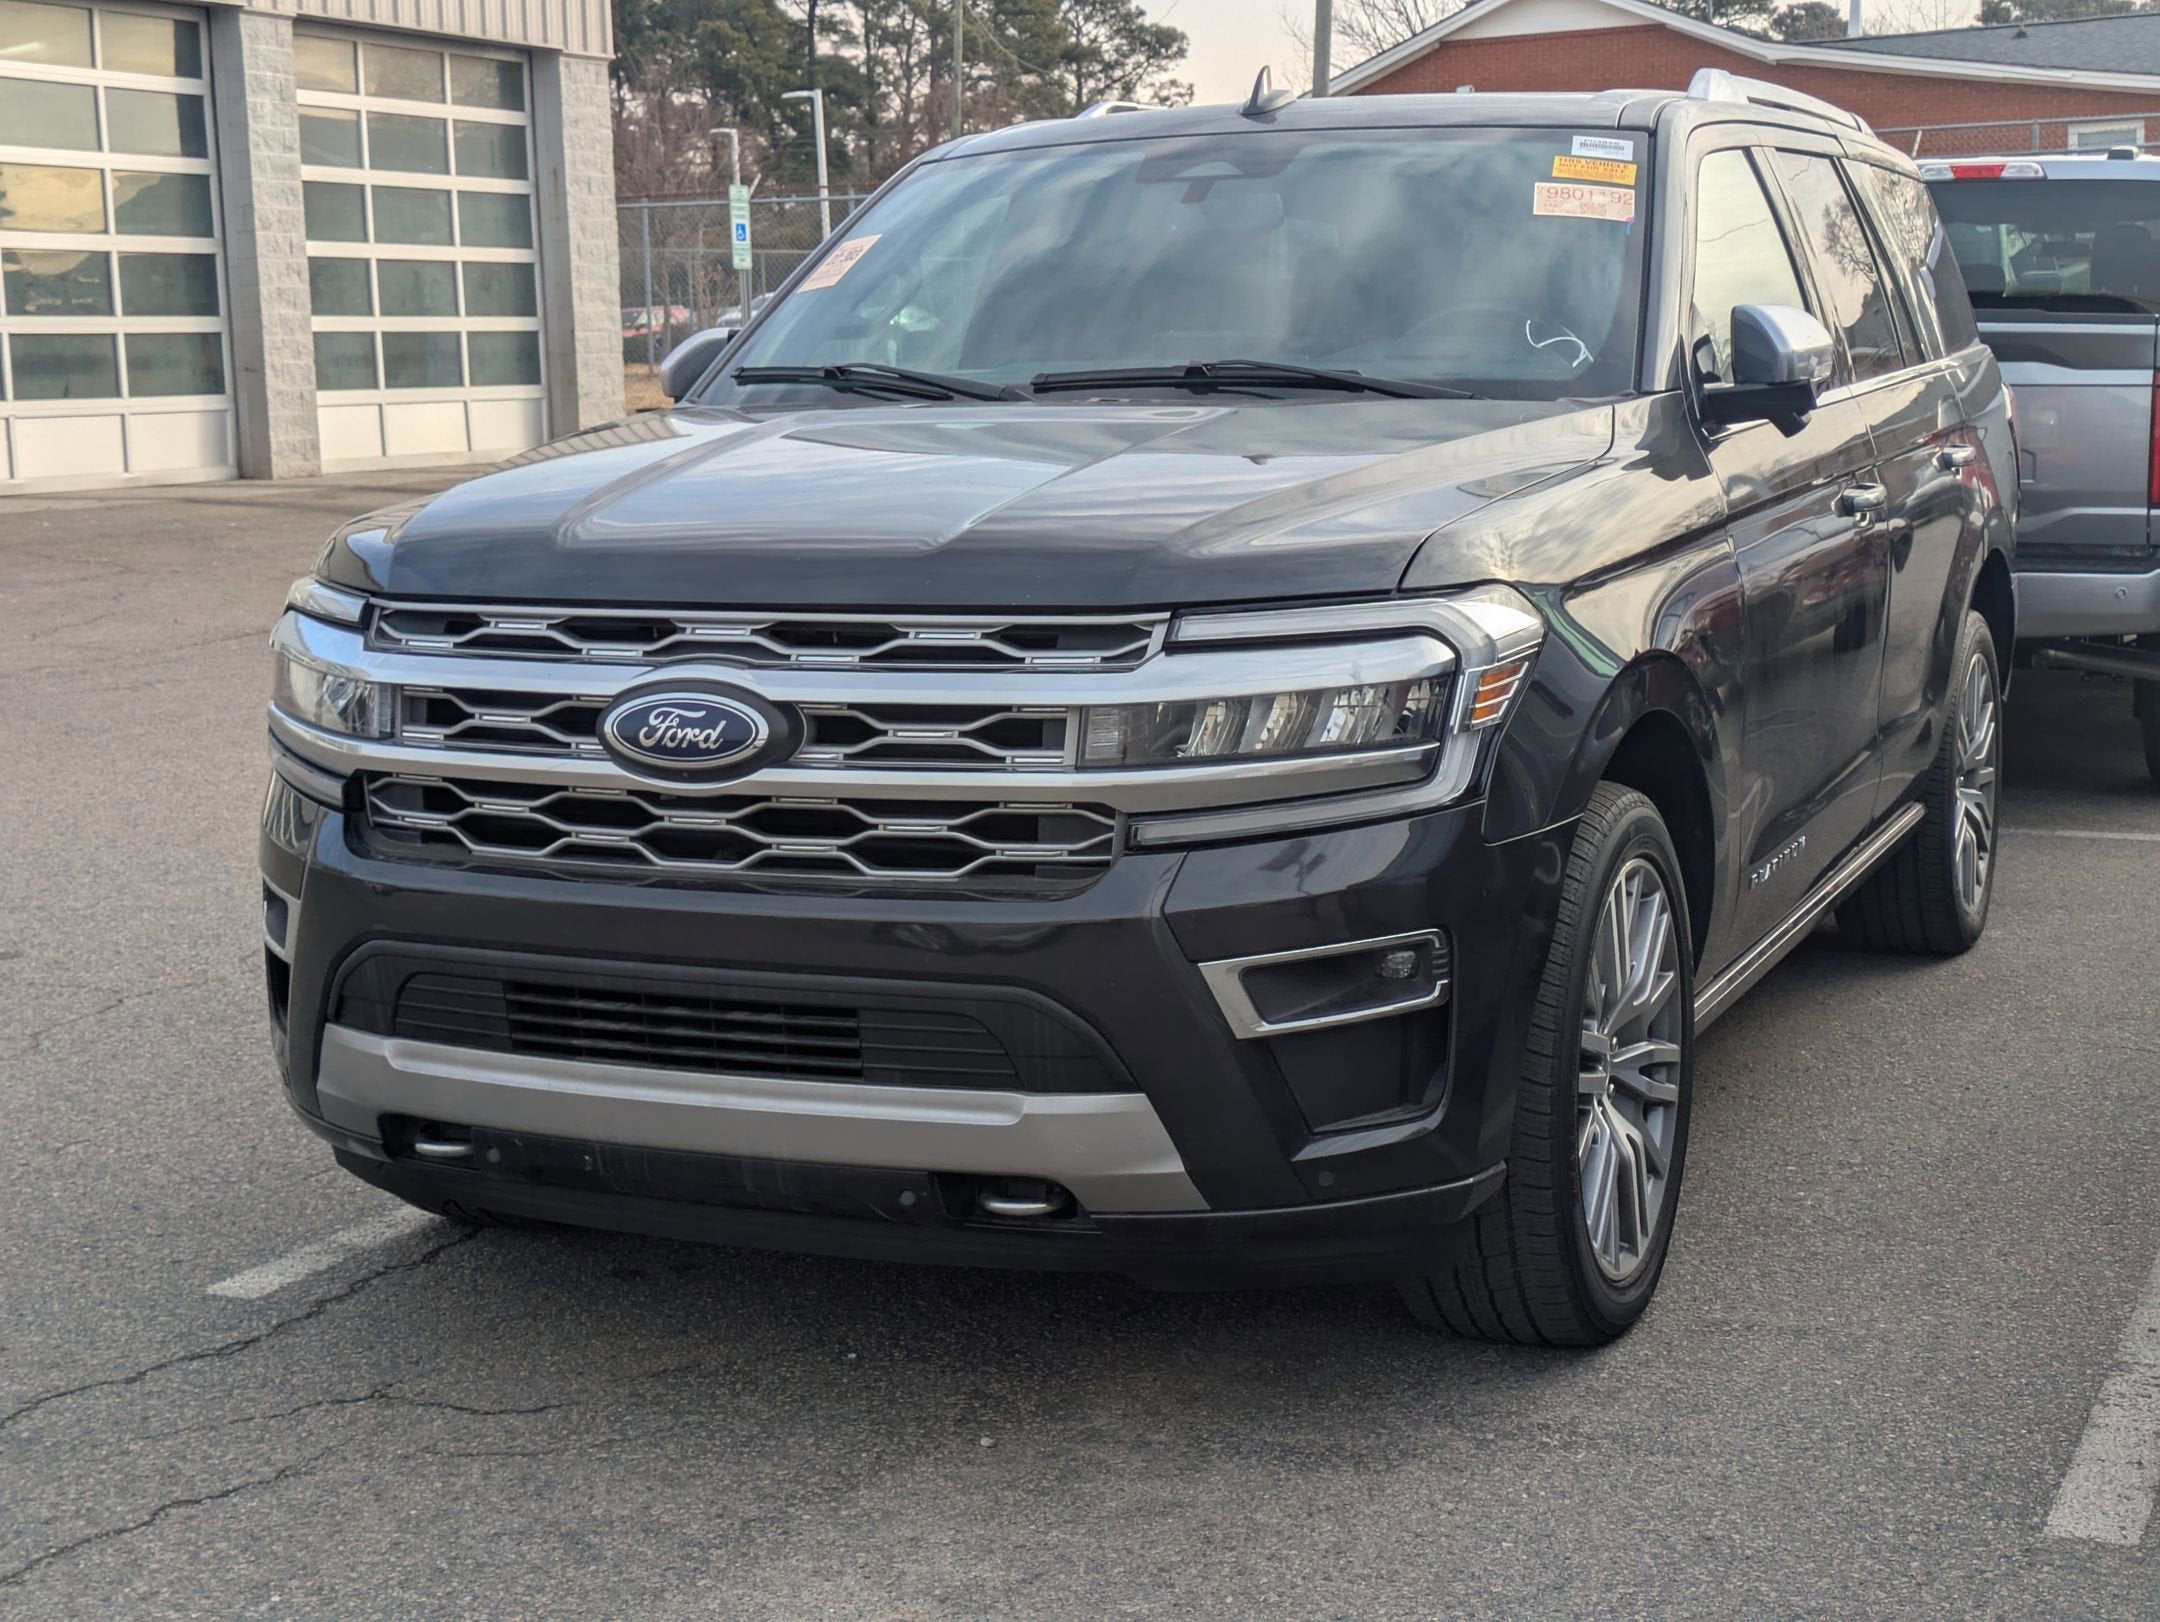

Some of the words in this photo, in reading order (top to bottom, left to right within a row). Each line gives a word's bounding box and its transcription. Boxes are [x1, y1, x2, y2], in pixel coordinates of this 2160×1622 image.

[1559, 157, 1581, 165] THIS
[1585, 159, 1630, 169] VEHICLE
[639, 706, 727, 750] Ford
